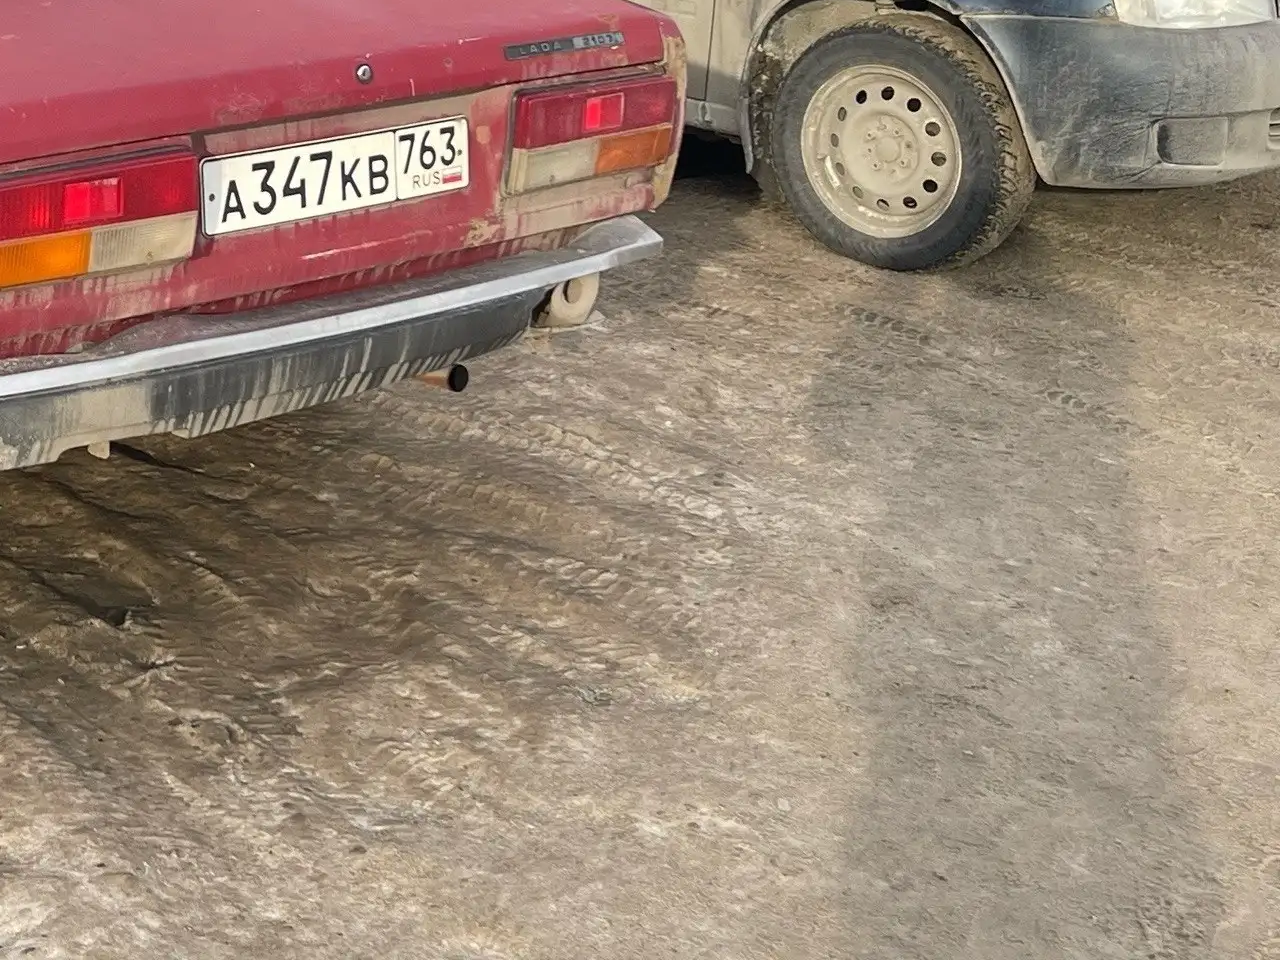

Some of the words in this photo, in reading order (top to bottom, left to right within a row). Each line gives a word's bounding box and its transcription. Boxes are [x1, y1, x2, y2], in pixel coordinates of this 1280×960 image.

[520, 41, 562, 55] LADA
[398, 126, 456, 175] 763
[412, 170, 441, 190] RUS
